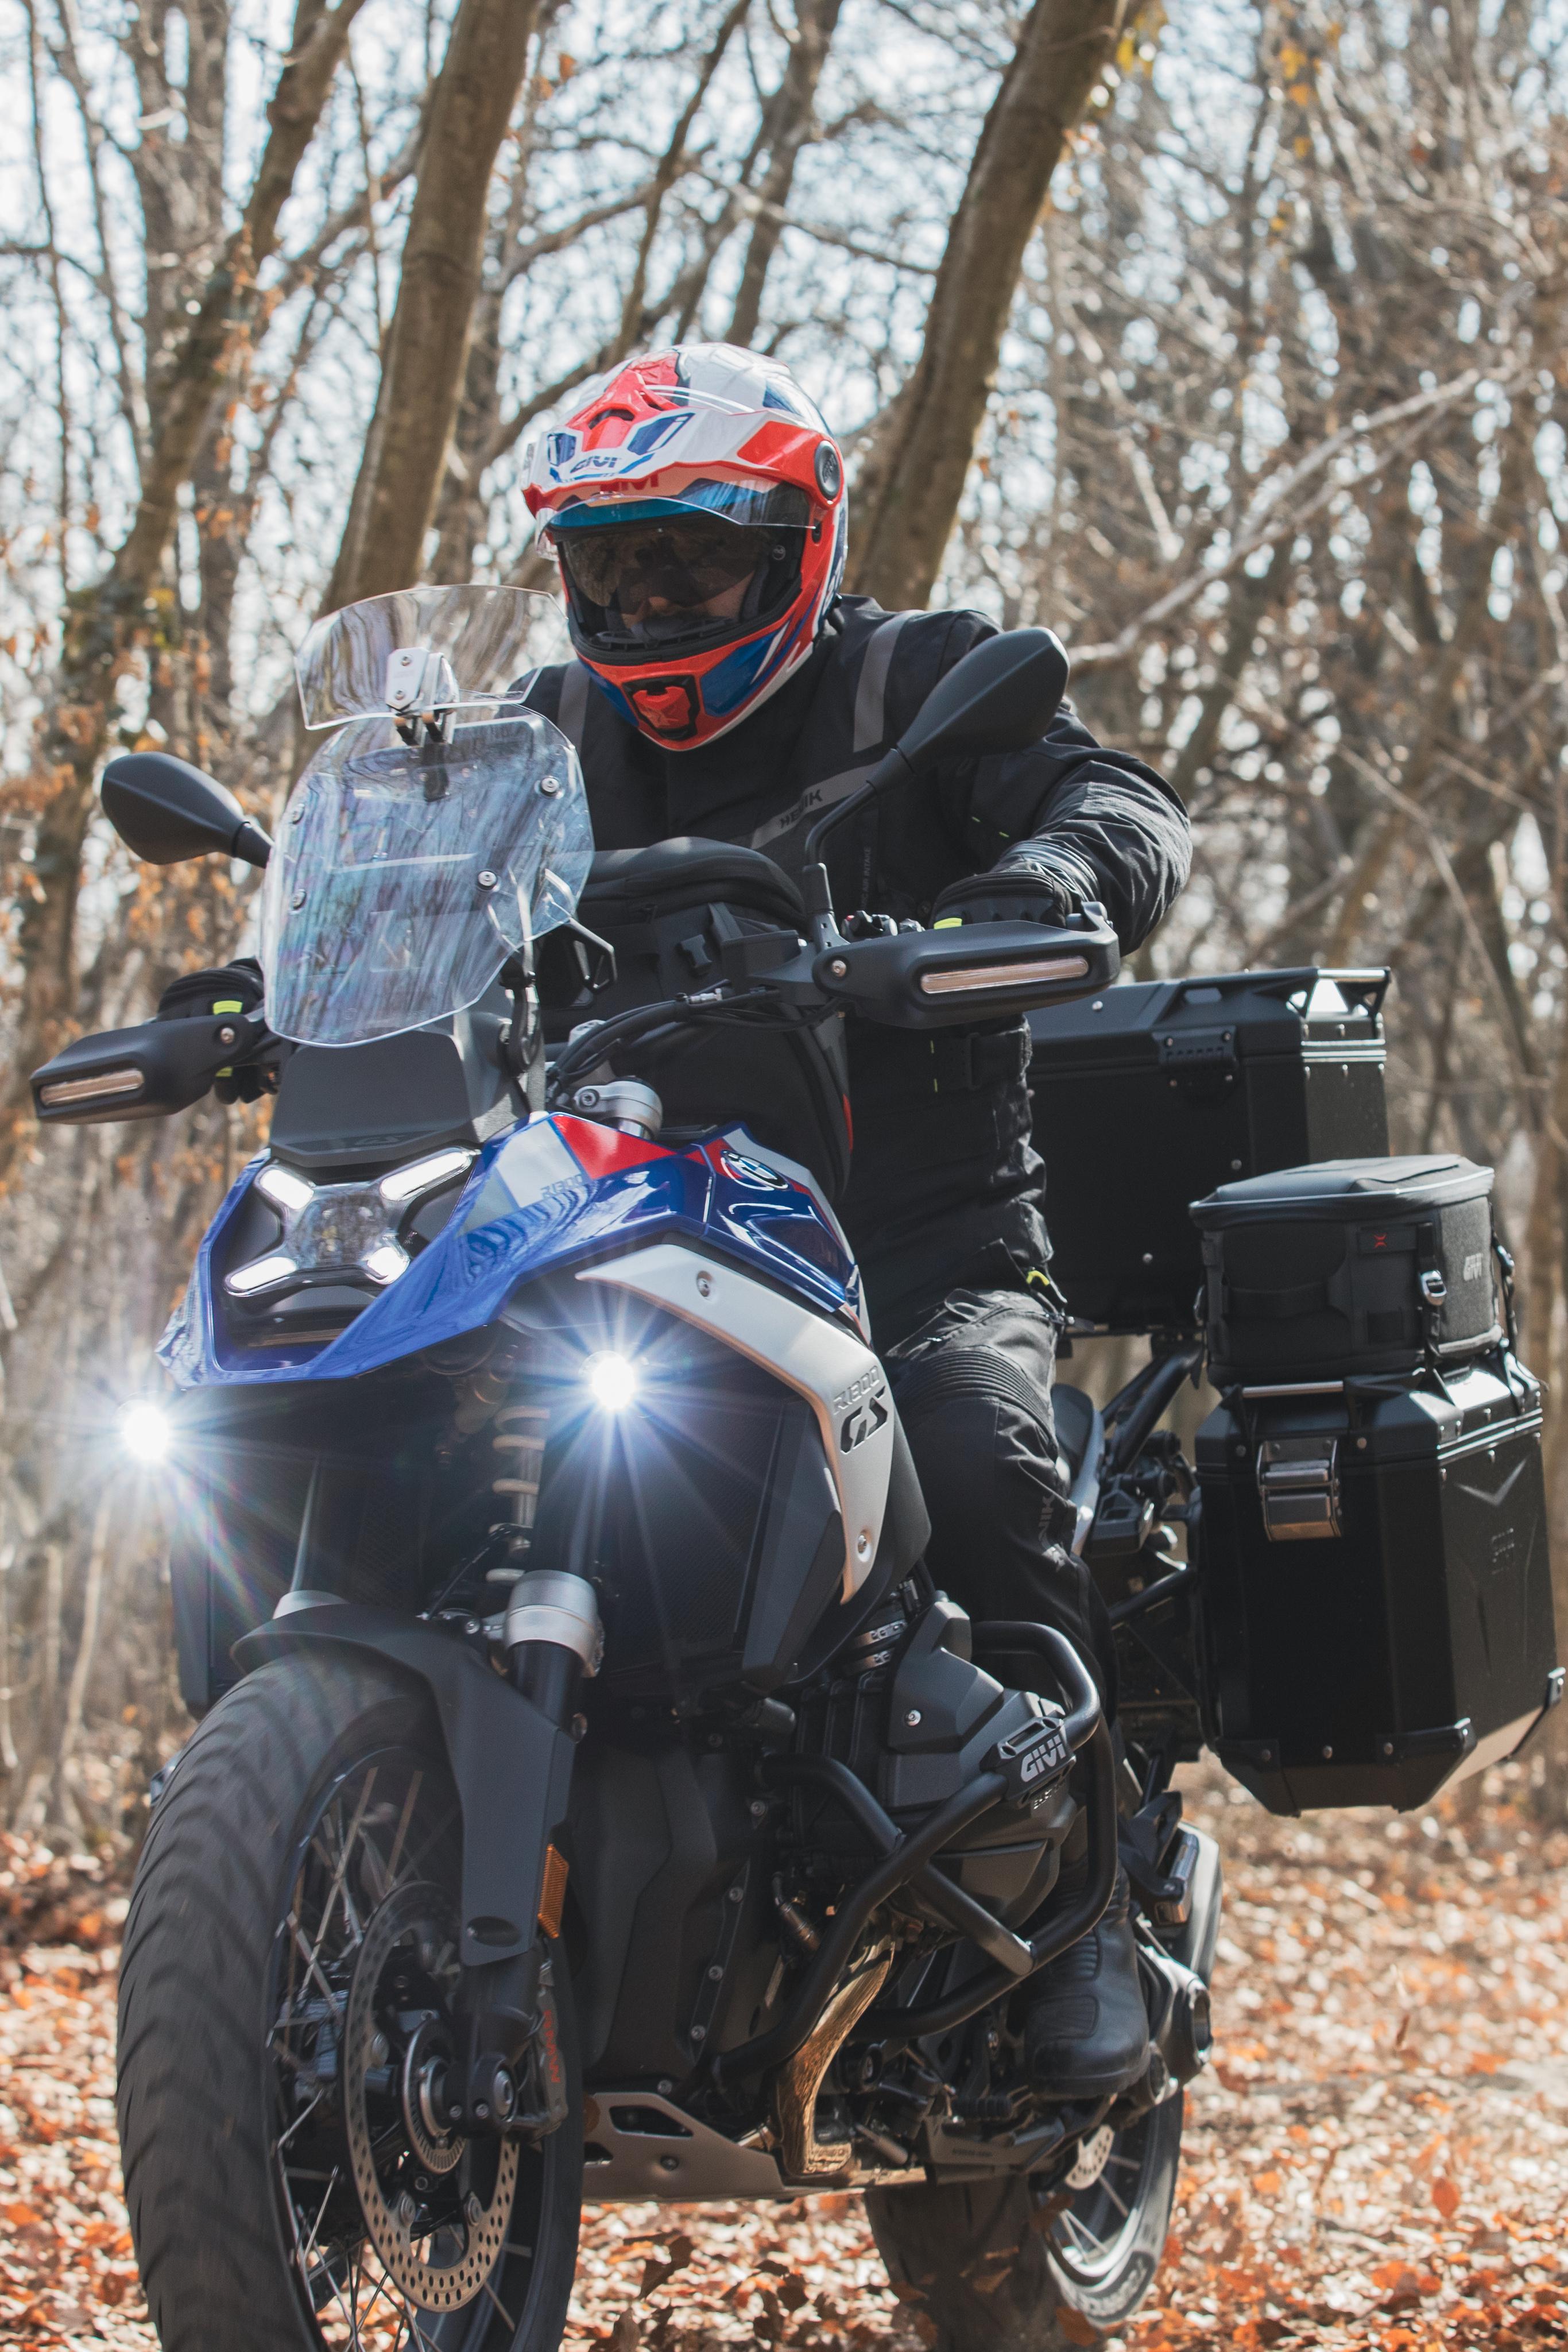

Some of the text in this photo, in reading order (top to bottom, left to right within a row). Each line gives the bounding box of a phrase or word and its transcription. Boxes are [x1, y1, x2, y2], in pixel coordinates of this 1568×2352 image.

[570, 456, 618, 474] GIVI
[841, 1385, 888, 1454] GS
[1020, 1734, 1066, 1782] GIVI
